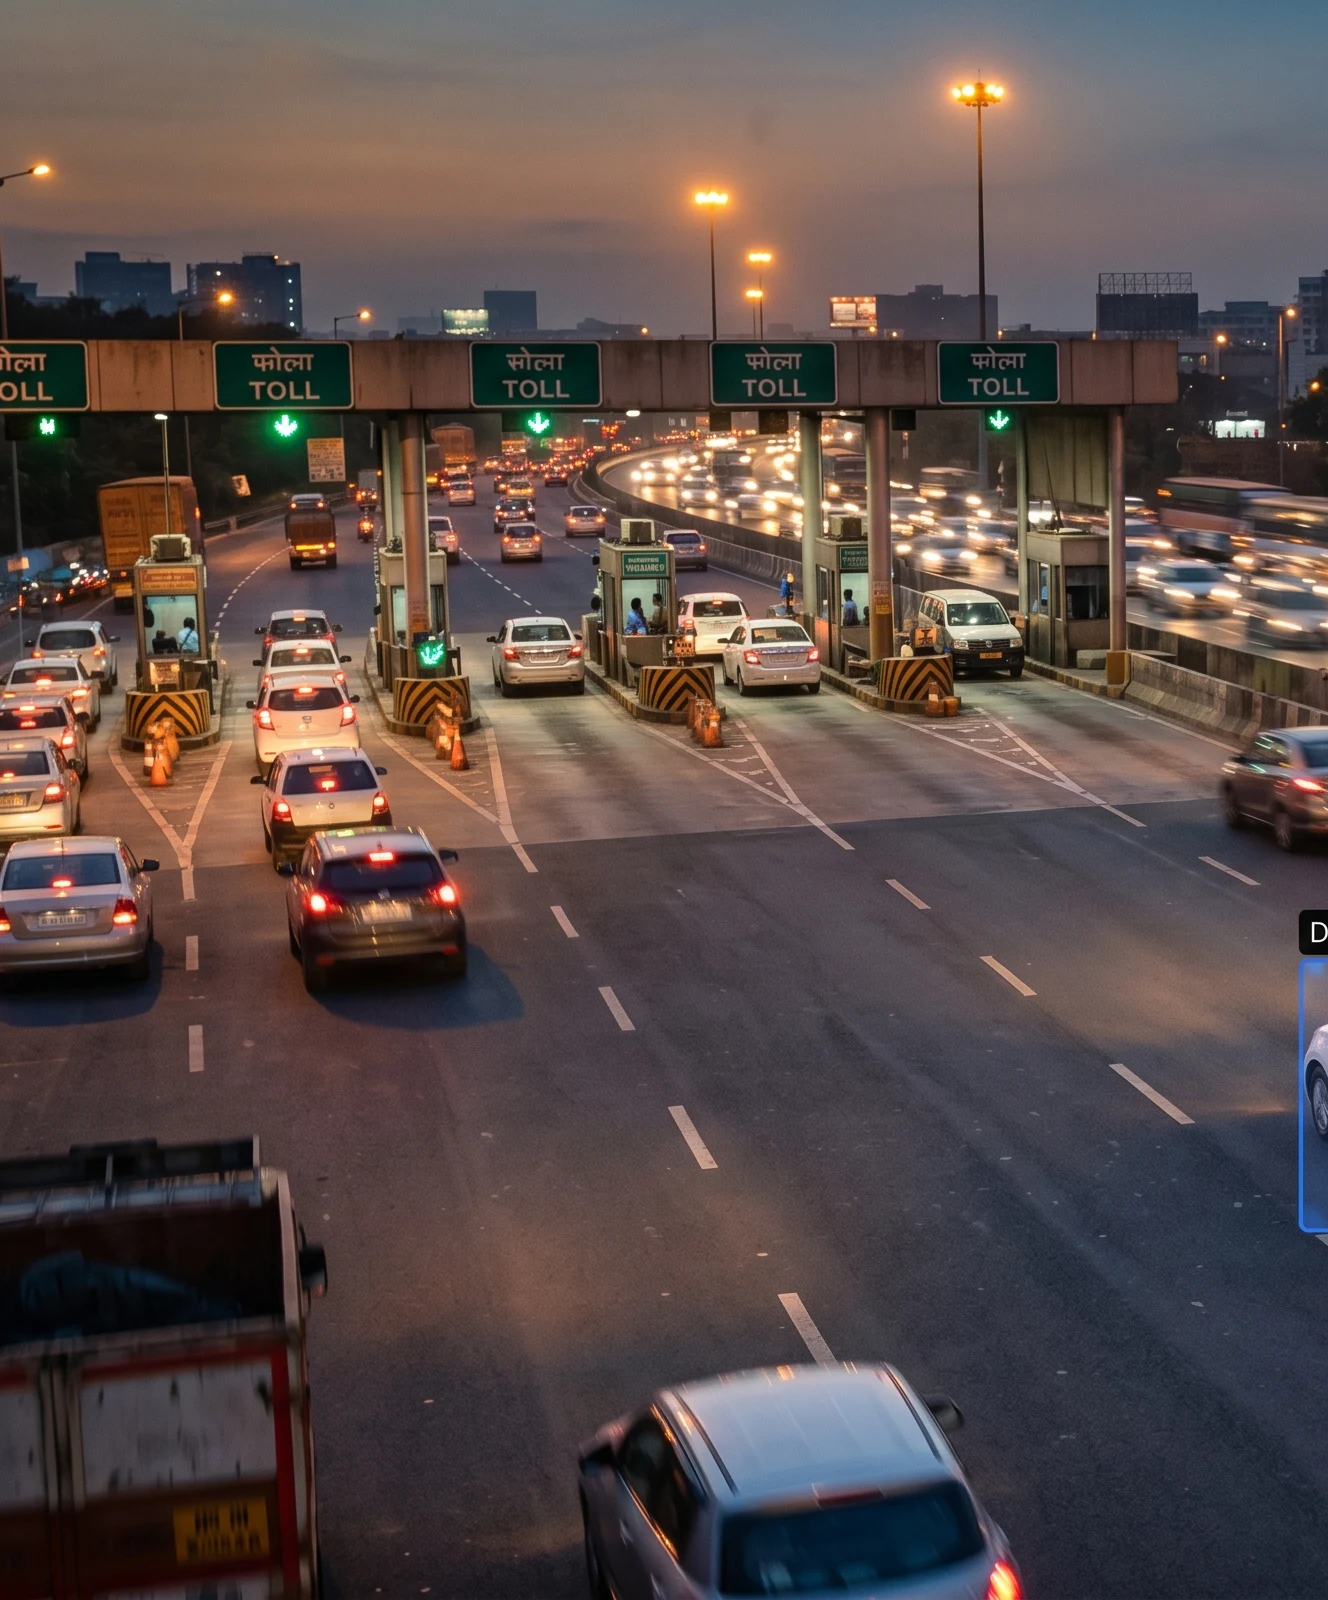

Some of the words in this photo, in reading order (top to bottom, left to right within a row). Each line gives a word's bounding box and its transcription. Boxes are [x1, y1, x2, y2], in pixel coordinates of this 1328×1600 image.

[0, 381, 54, 401] OLL
[249, 381, 320, 400] TOLL
[502, 379, 570, 398] TOLL
[742, 378, 807, 397] TOLL
[968, 378, 1029, 396] TOLL
